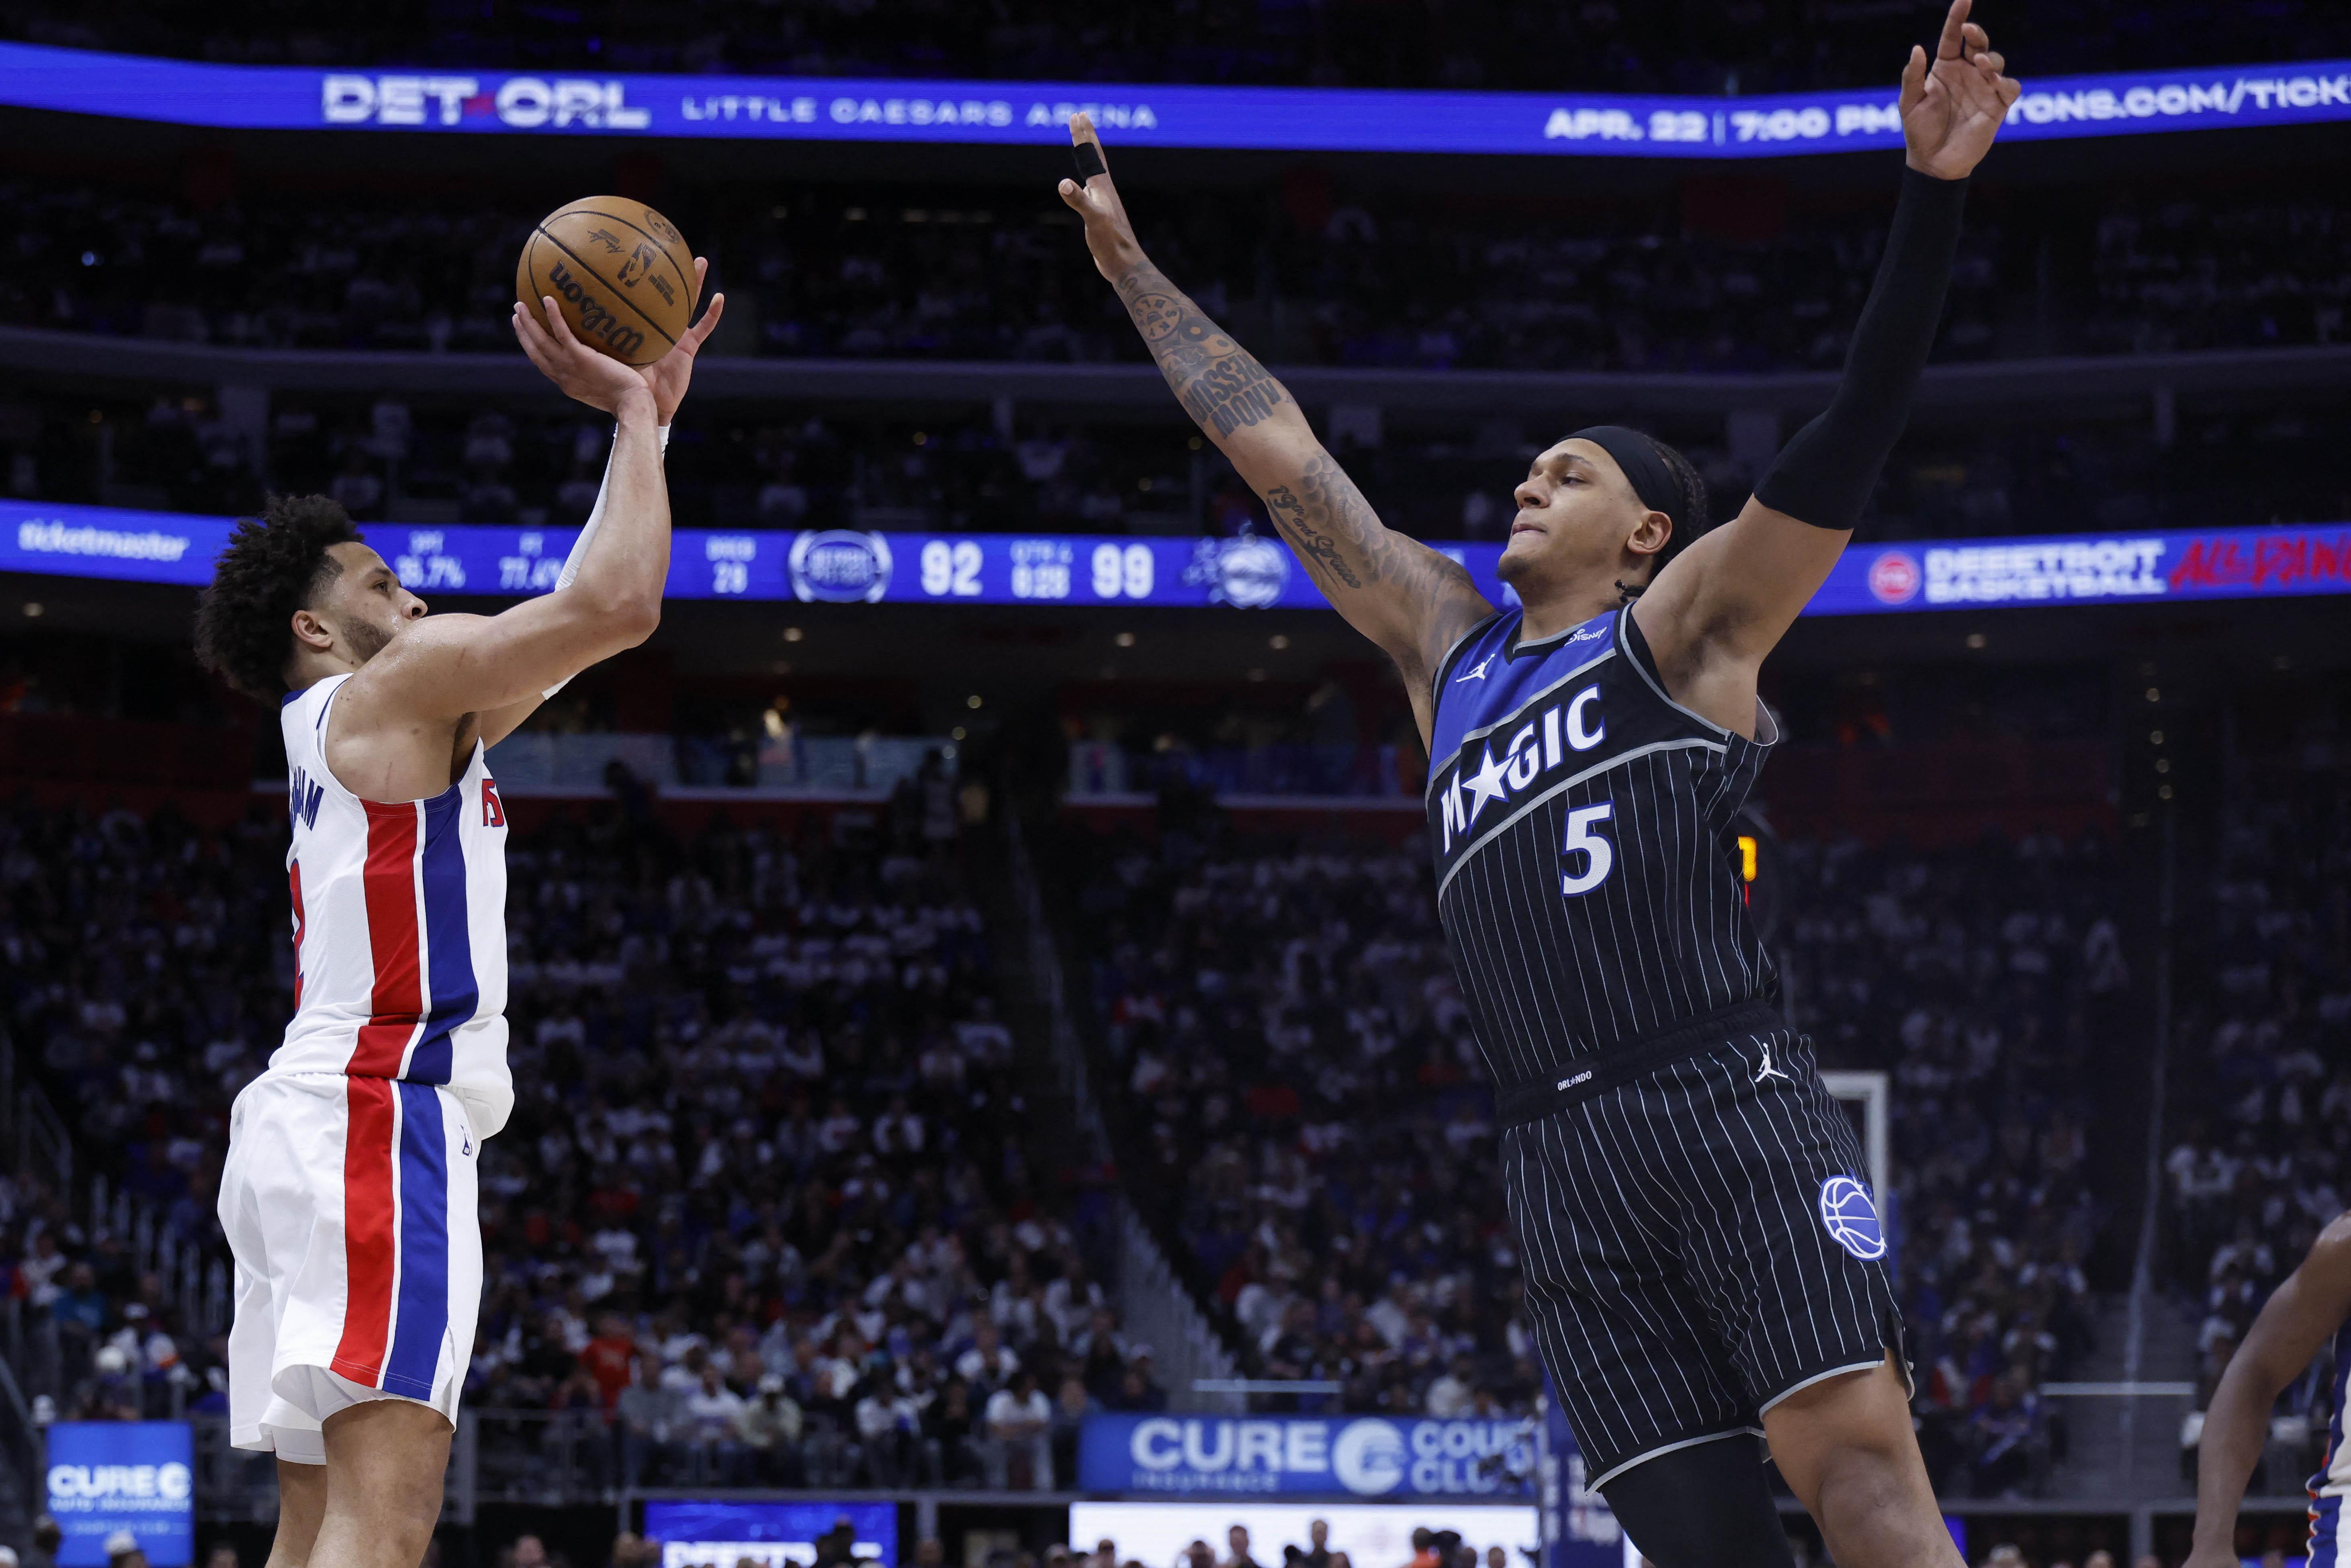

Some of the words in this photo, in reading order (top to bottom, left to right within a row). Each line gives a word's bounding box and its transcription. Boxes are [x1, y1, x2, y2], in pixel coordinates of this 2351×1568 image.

[323, 73, 479, 125] DET
[495, 77, 651, 129] ORL
[681, 95, 818, 123] LITTLE
[830, 98, 1013, 128] CAESARS
[1025, 101, 1158, 129] ARENA
[1544, 108, 1645, 141] APR.
[1648, 111, 1708, 142] 22
[1731, 107, 1831, 141] 7:00
[1835, 102, 1903, 137] PM
[550, 260, 645, 358] Wilson
[1211, 379, 1281, 440] KNOW
[1293, 518, 1317, 536] and
[921, 540, 983, 596] 92
[1092, 543, 1154, 599] 99
[1440, 683, 1605, 856] MAGIC
[1560, 800, 1615, 897] 5
[1557, 1071, 1592, 1091] ORLANDO
[1131, 1417, 1330, 1472] CURE
[47, 1464, 158, 1498] CURE
